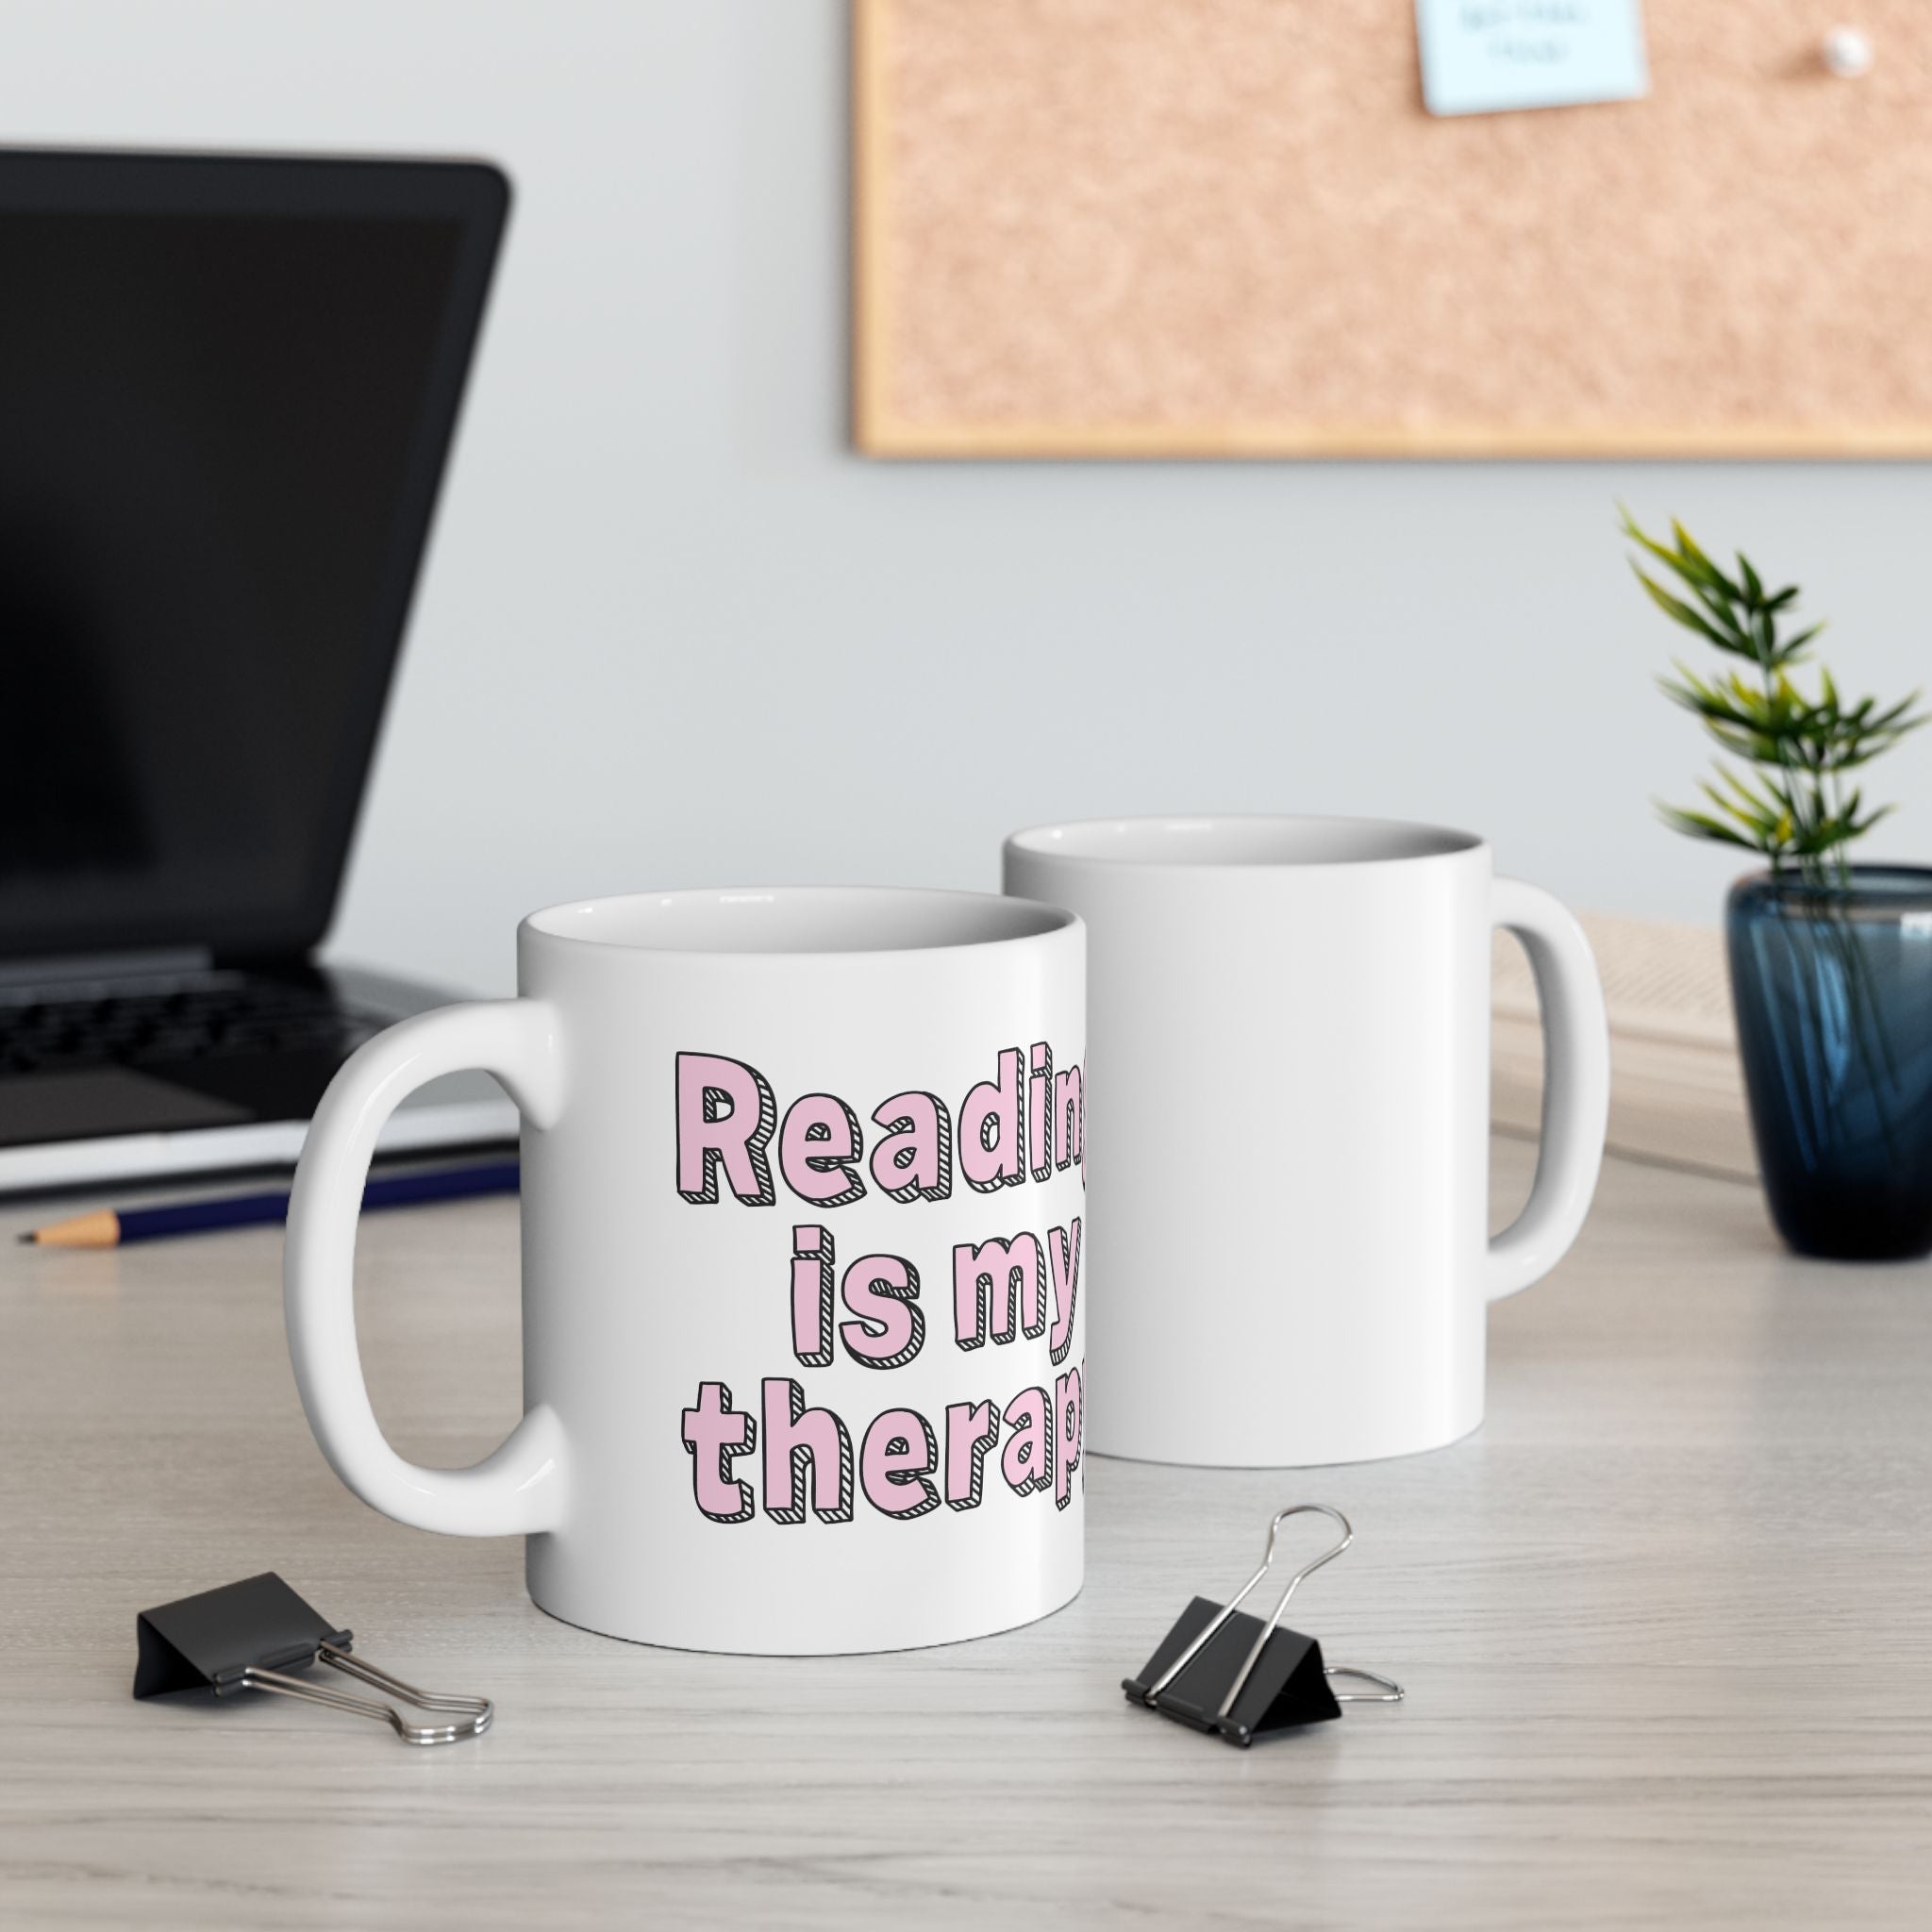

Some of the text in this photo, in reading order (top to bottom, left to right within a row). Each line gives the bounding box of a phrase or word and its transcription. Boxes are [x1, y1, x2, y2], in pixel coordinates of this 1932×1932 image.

[675, 1041, 1086, 1208] Readin
[791, 1217, 1082, 1370] is my
[681, 1358, 1086, 1524] therap
